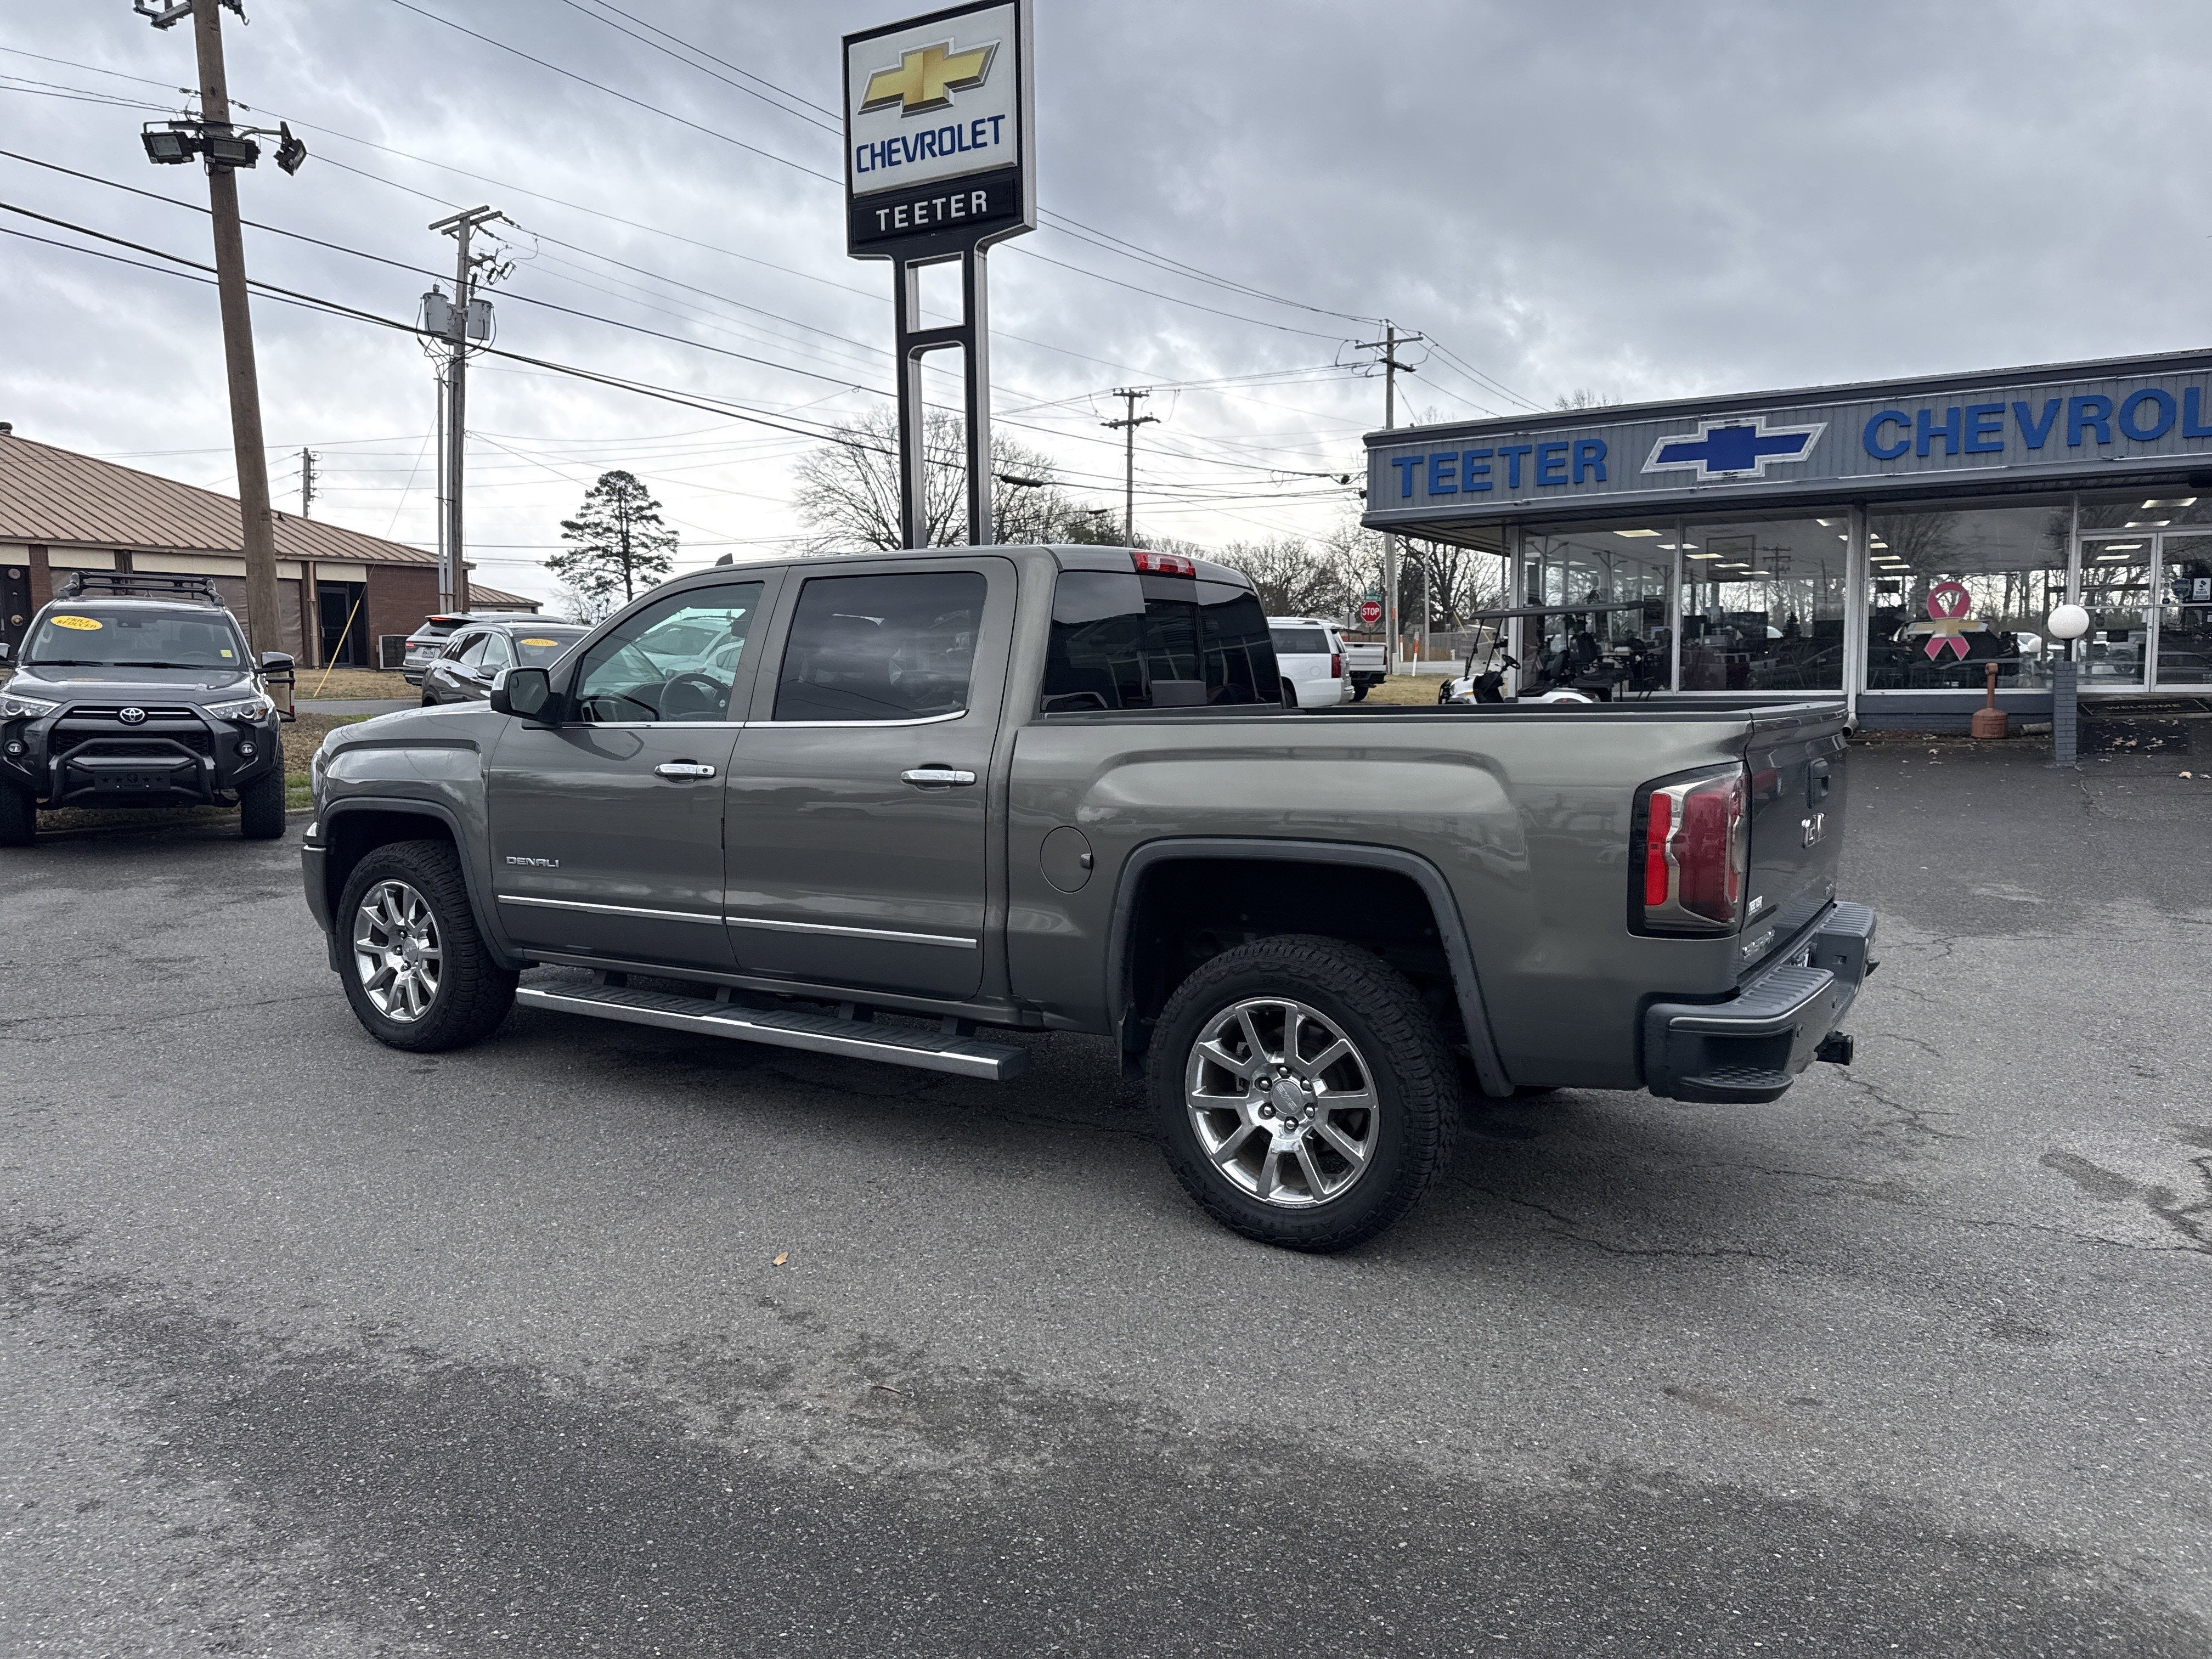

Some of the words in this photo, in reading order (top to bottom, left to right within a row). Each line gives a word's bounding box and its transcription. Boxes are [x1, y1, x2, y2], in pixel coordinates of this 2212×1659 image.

[856, 114, 1005, 173] CHEVROLET
[876, 190, 987, 231] TEETER
[1863, 387, 2212, 460] CHEVROL
[1392, 439, 1607, 496] TEETER
[1362, 607, 1380, 616] STOP
[506, 856, 559, 868] DENALI
